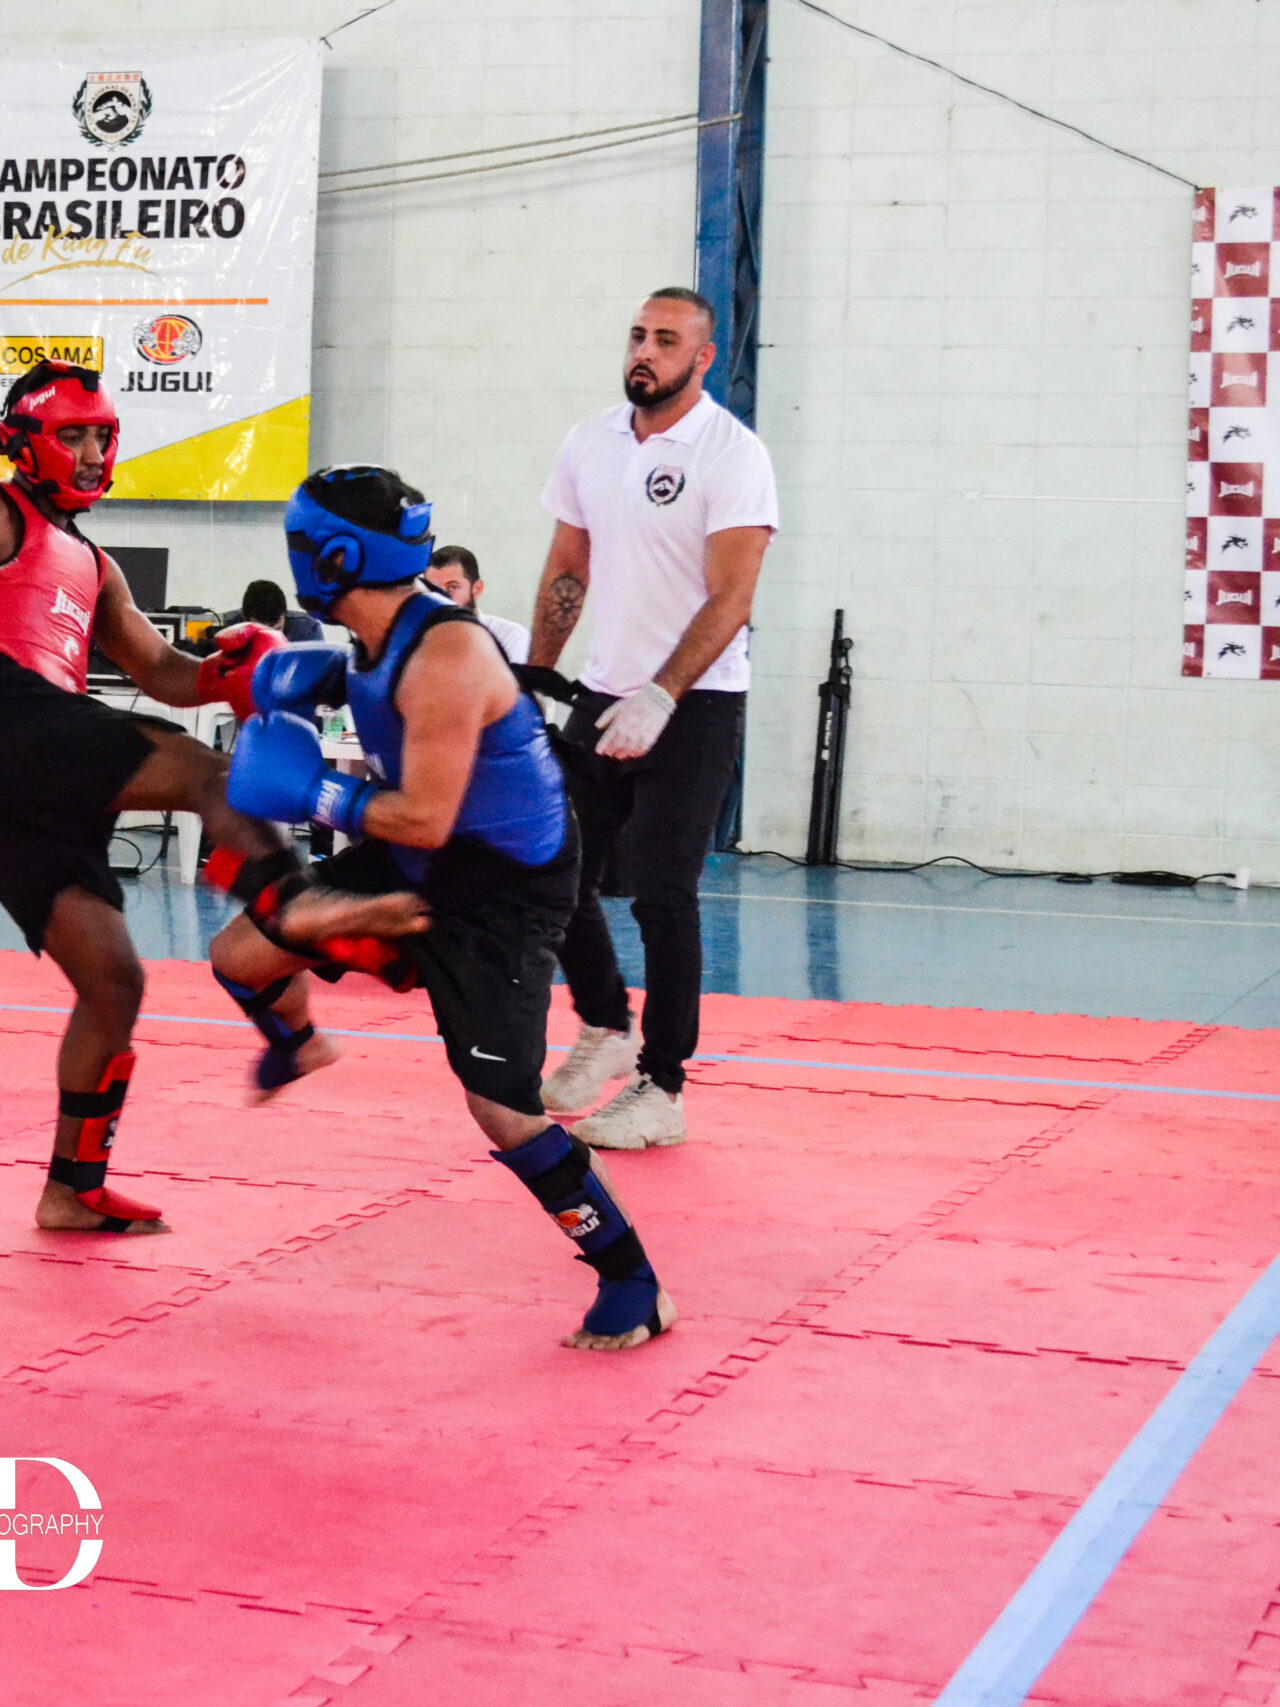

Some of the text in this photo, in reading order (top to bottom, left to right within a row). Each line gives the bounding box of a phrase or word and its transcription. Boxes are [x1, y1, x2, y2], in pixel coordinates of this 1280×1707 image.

[1, 223, 154, 265] de Kung Fu
[3, 346, 97, 365] COSAMA
[120, 370, 213, 393] JUGUI
